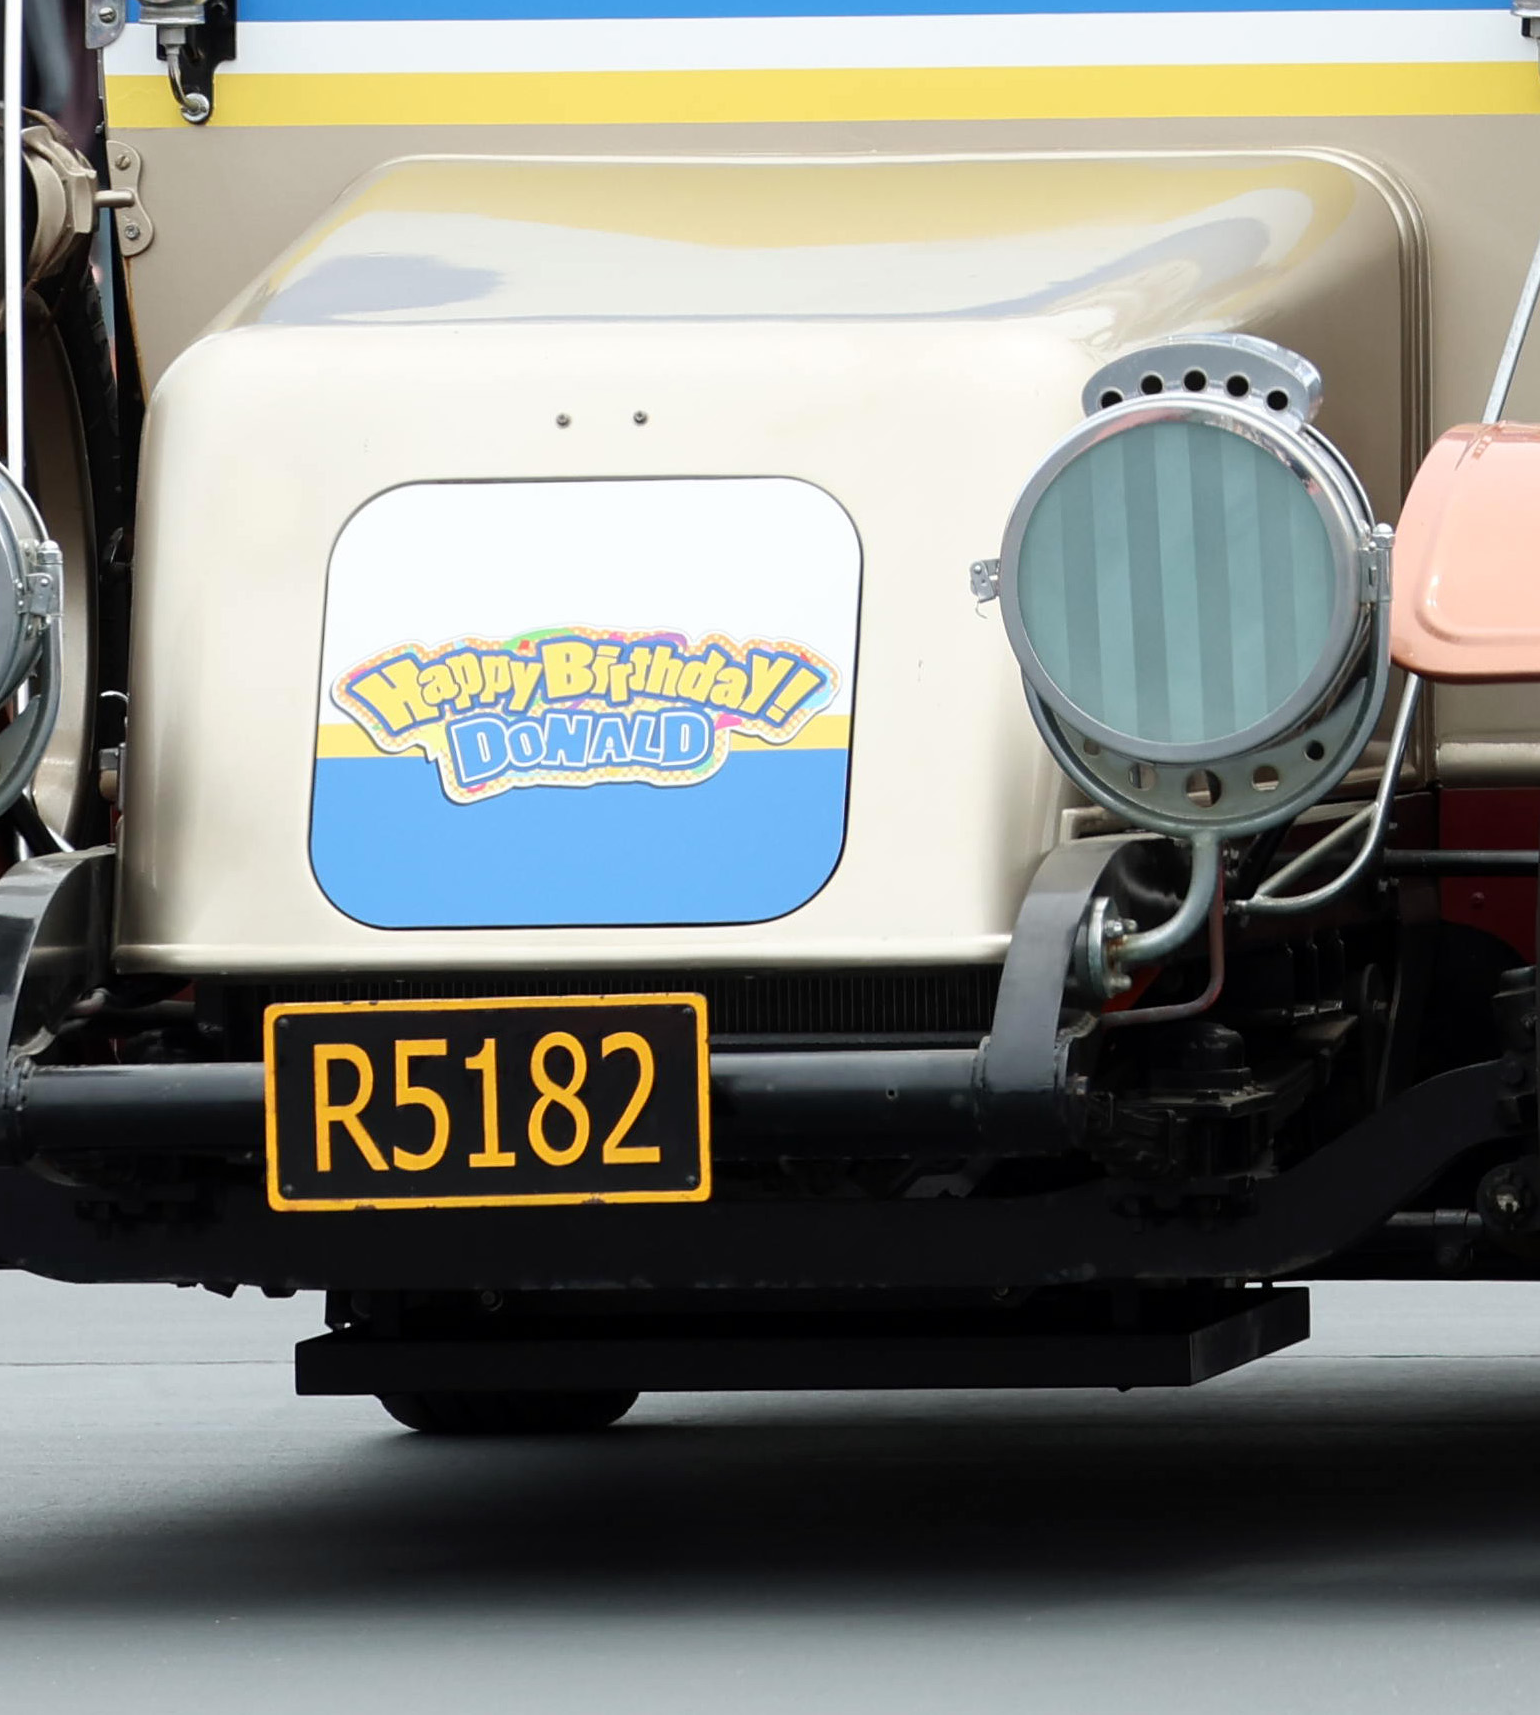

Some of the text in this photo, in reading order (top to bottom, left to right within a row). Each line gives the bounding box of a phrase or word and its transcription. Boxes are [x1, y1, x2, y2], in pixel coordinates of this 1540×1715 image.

[352, 650, 542, 732] Happy
[448, 713, 711, 786] DONALD
[313, 1031, 662, 1172] R5182
